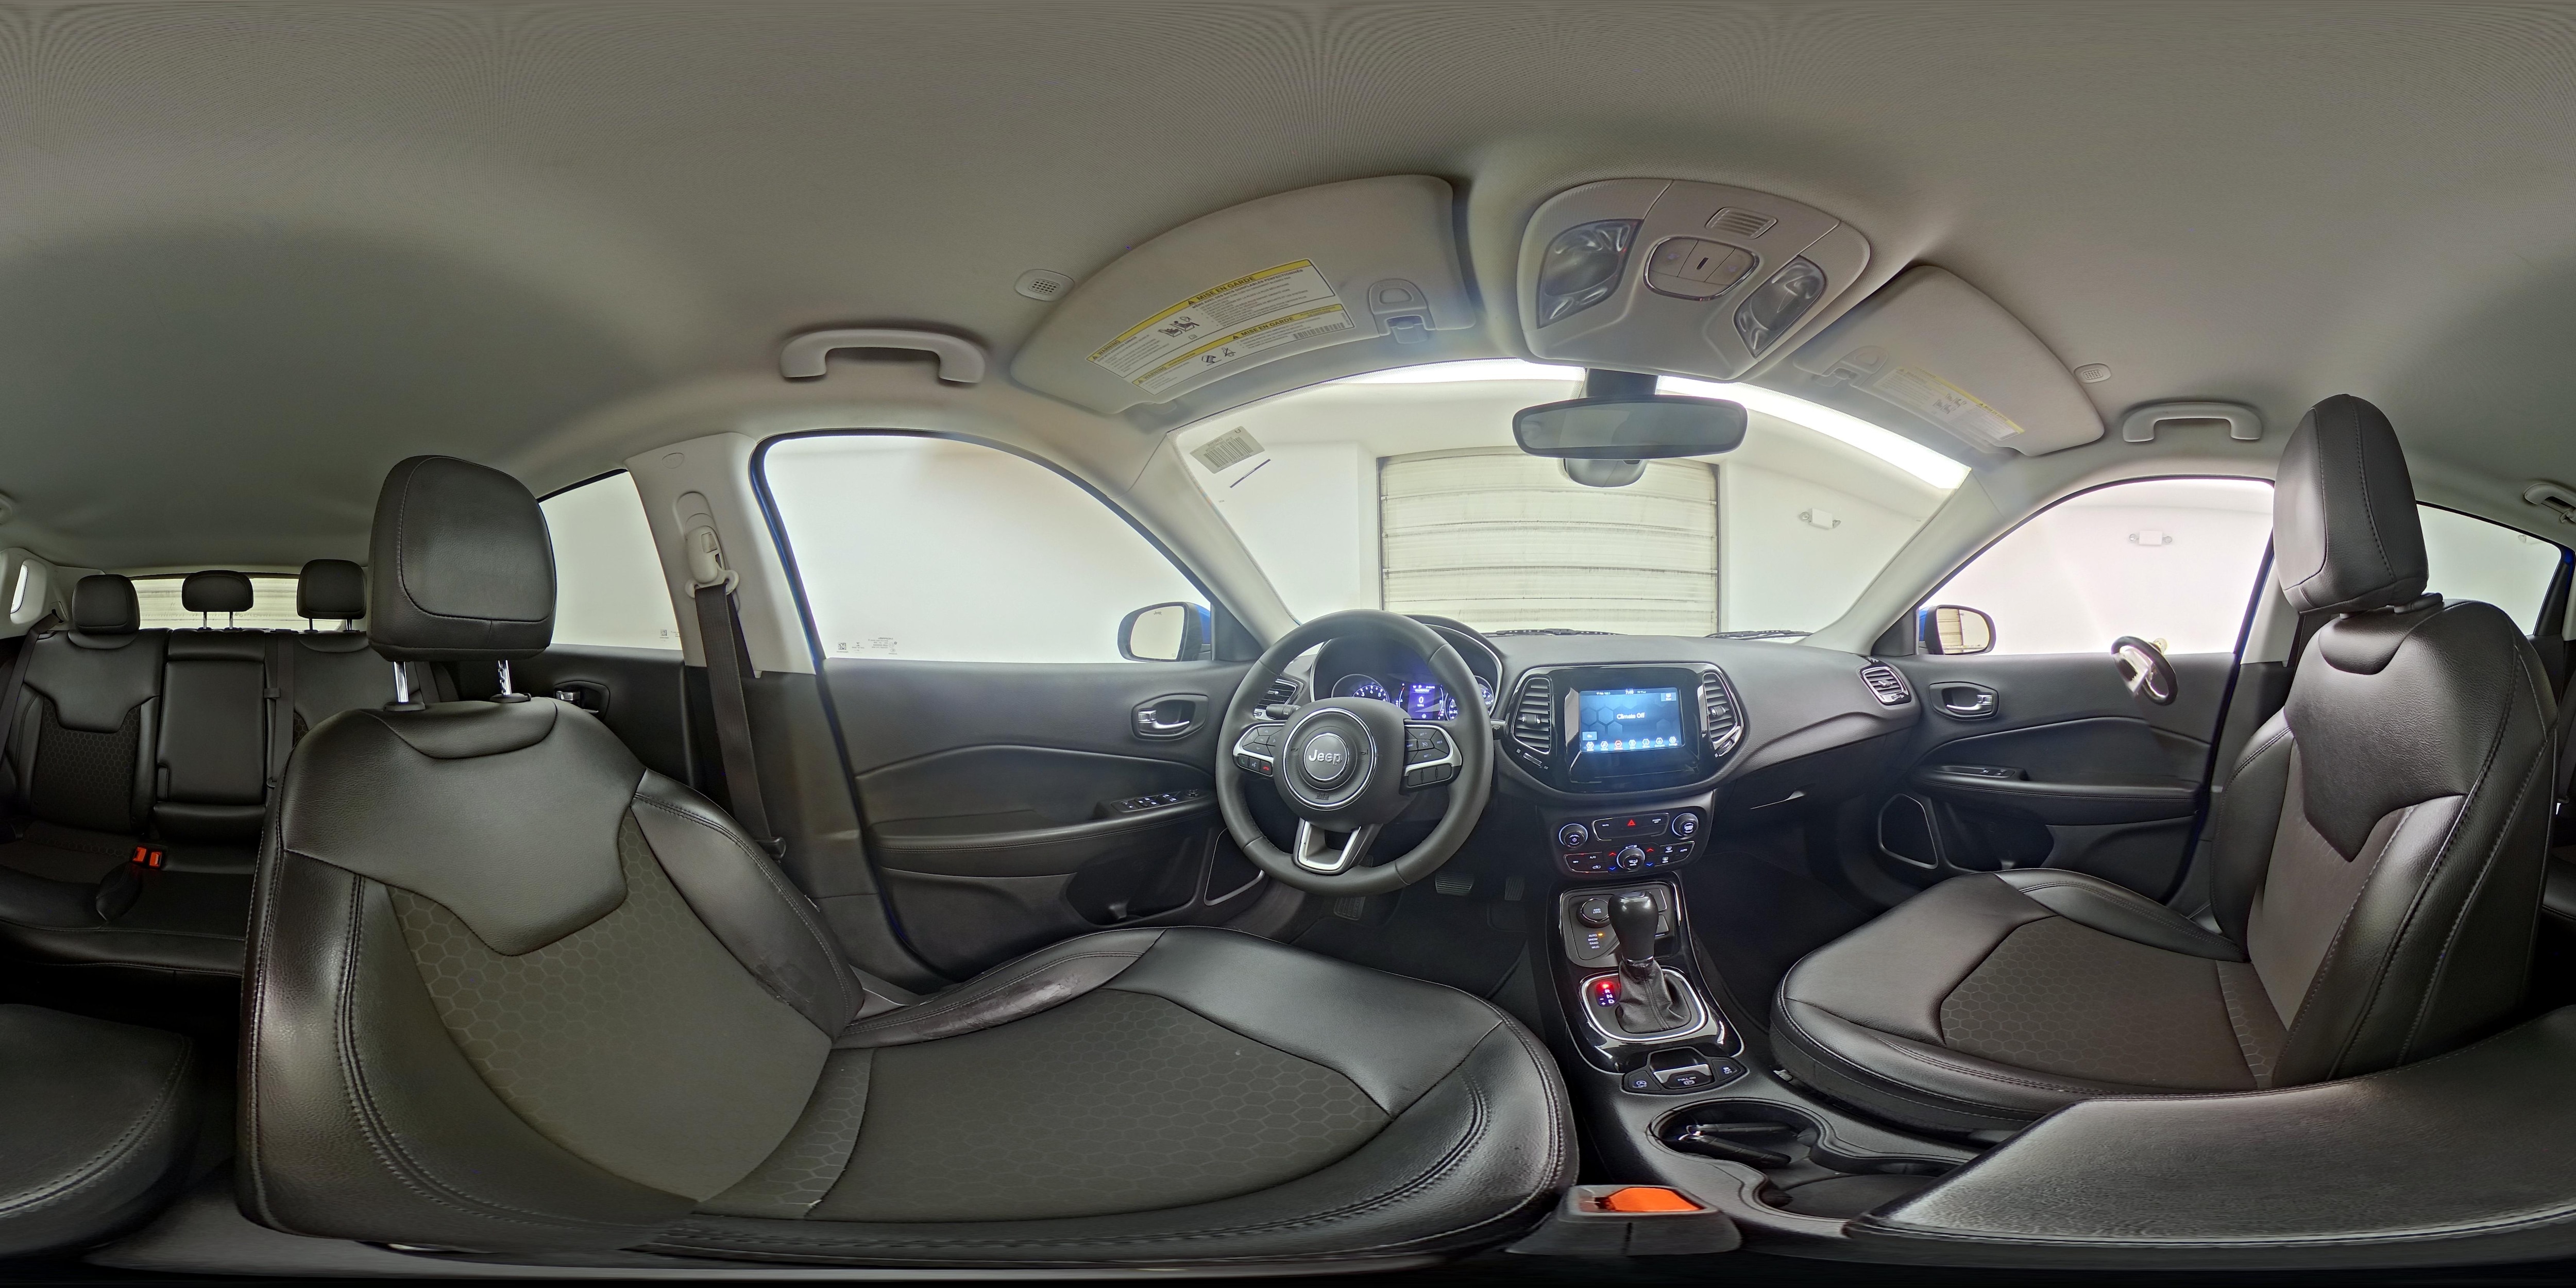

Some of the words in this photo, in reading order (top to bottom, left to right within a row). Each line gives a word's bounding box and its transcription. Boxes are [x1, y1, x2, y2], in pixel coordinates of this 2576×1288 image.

[1196, 290, 1215, 300] MISE
[1227, 276, 1256, 287] GARDE
[1269, 316, 1294, 326] GARDE
[1096, 340, 1121, 355] WARNING
[1142, 365, 1167, 379] WARNING
[1308, 749, 1343, 766] Jeep
